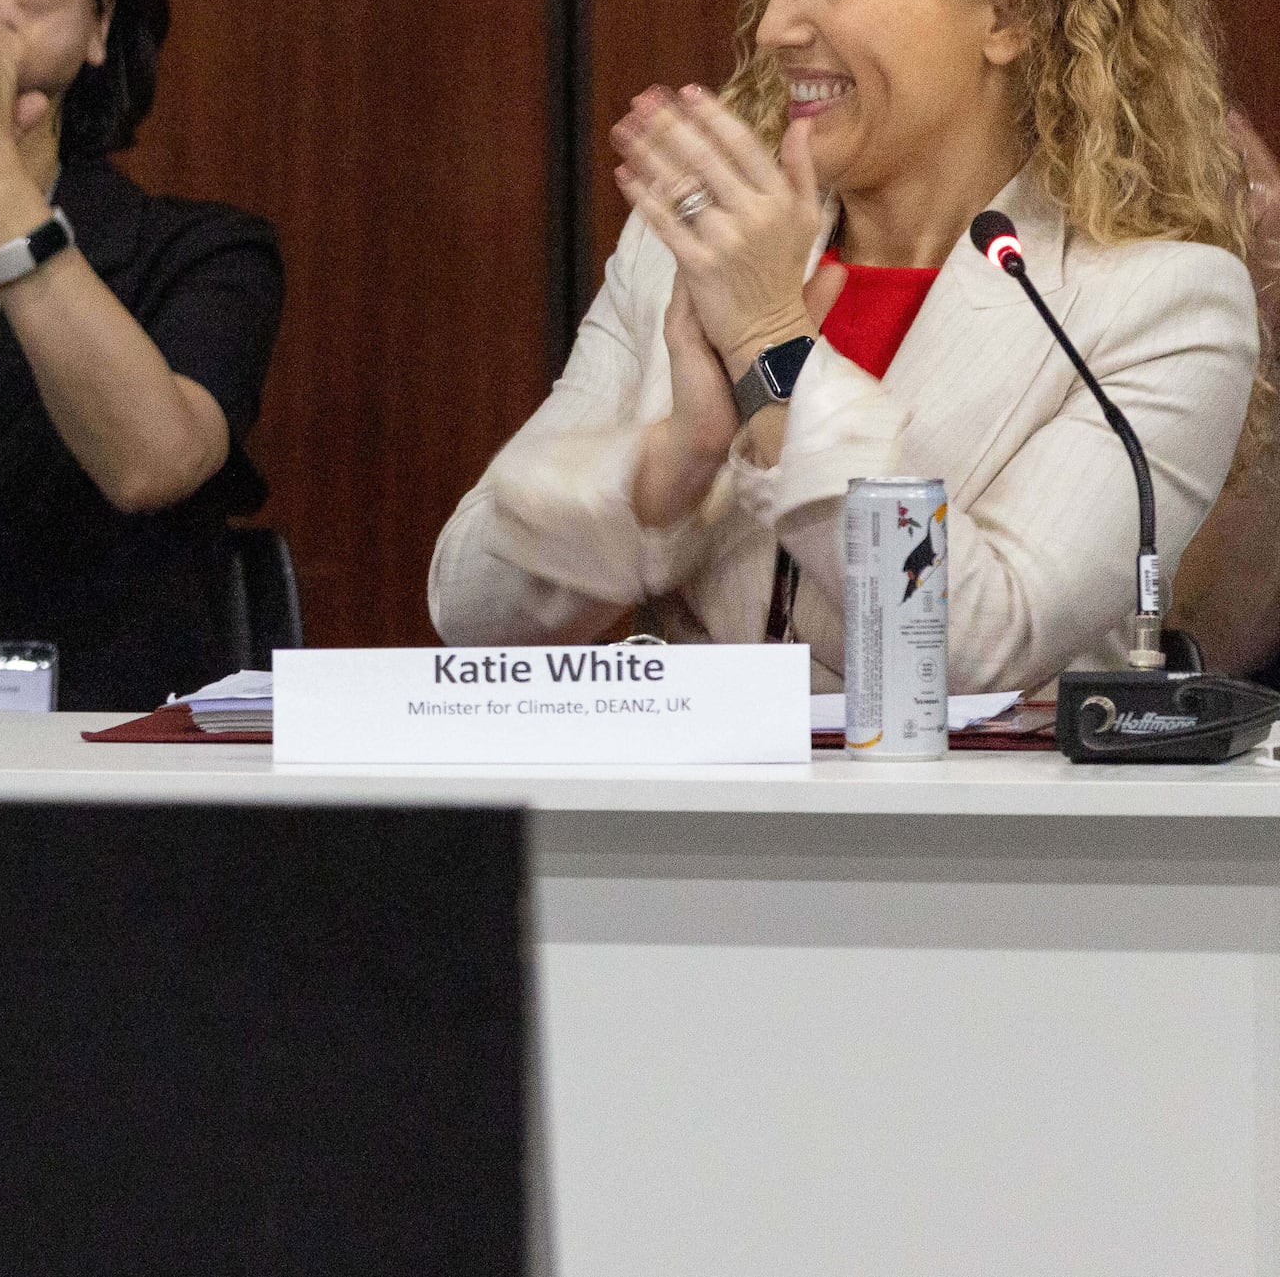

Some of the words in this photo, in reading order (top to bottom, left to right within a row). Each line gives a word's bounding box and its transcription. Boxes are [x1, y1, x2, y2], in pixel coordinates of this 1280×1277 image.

[434, 652, 532, 684] Katie
[545, 650, 665, 683] White
[408, 700, 481, 716] Minister
[486, 700, 512, 715] for
[517, 699, 589, 716] Climate,
[595, 698, 661, 714] DEANZ,
[666, 697, 691, 712] UK
